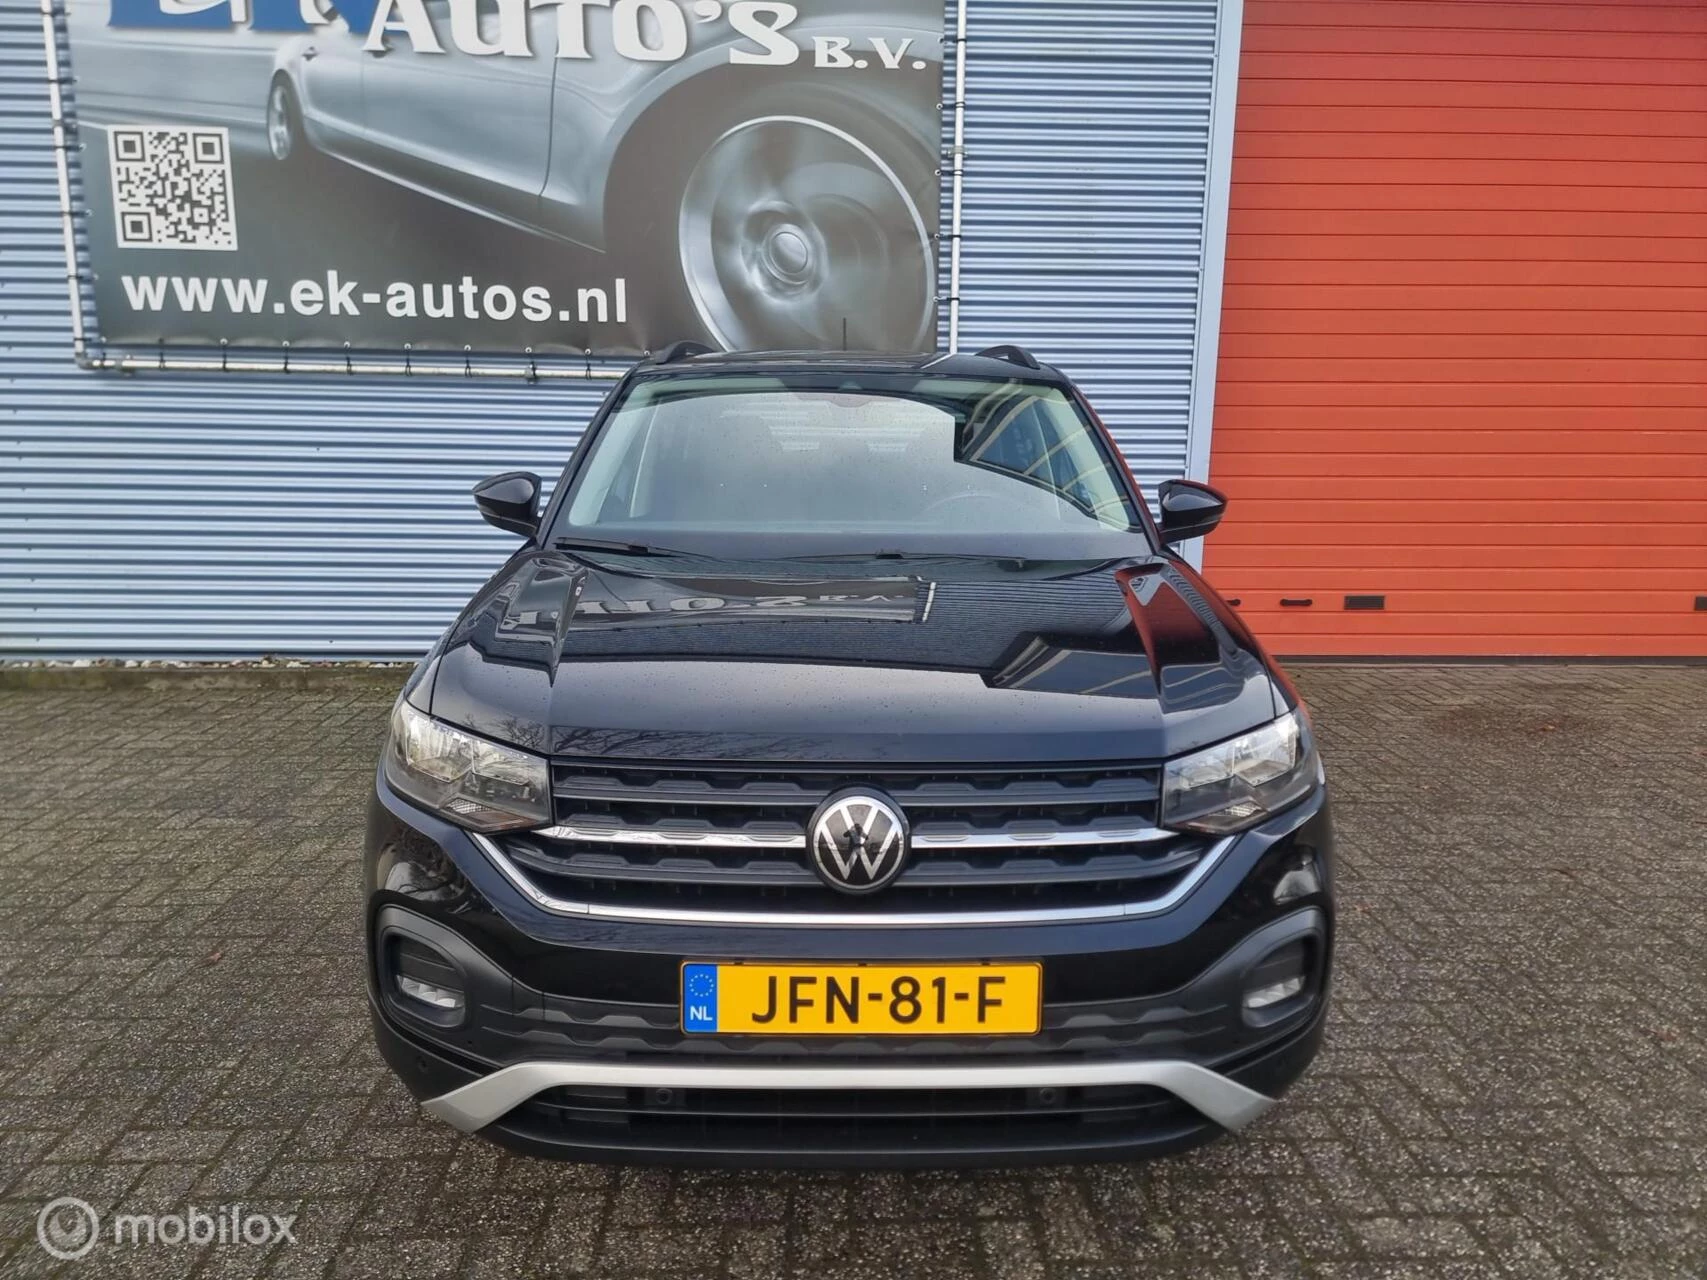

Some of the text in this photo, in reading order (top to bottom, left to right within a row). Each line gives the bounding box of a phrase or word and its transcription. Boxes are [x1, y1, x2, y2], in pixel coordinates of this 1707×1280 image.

[812, 36, 926, 69] B.V.
[121, 270, 627, 323] www.ek-autos.nl
[690, 1005, 713, 1021] NL
[751, 975, 1006, 1025] JFN-81-F
